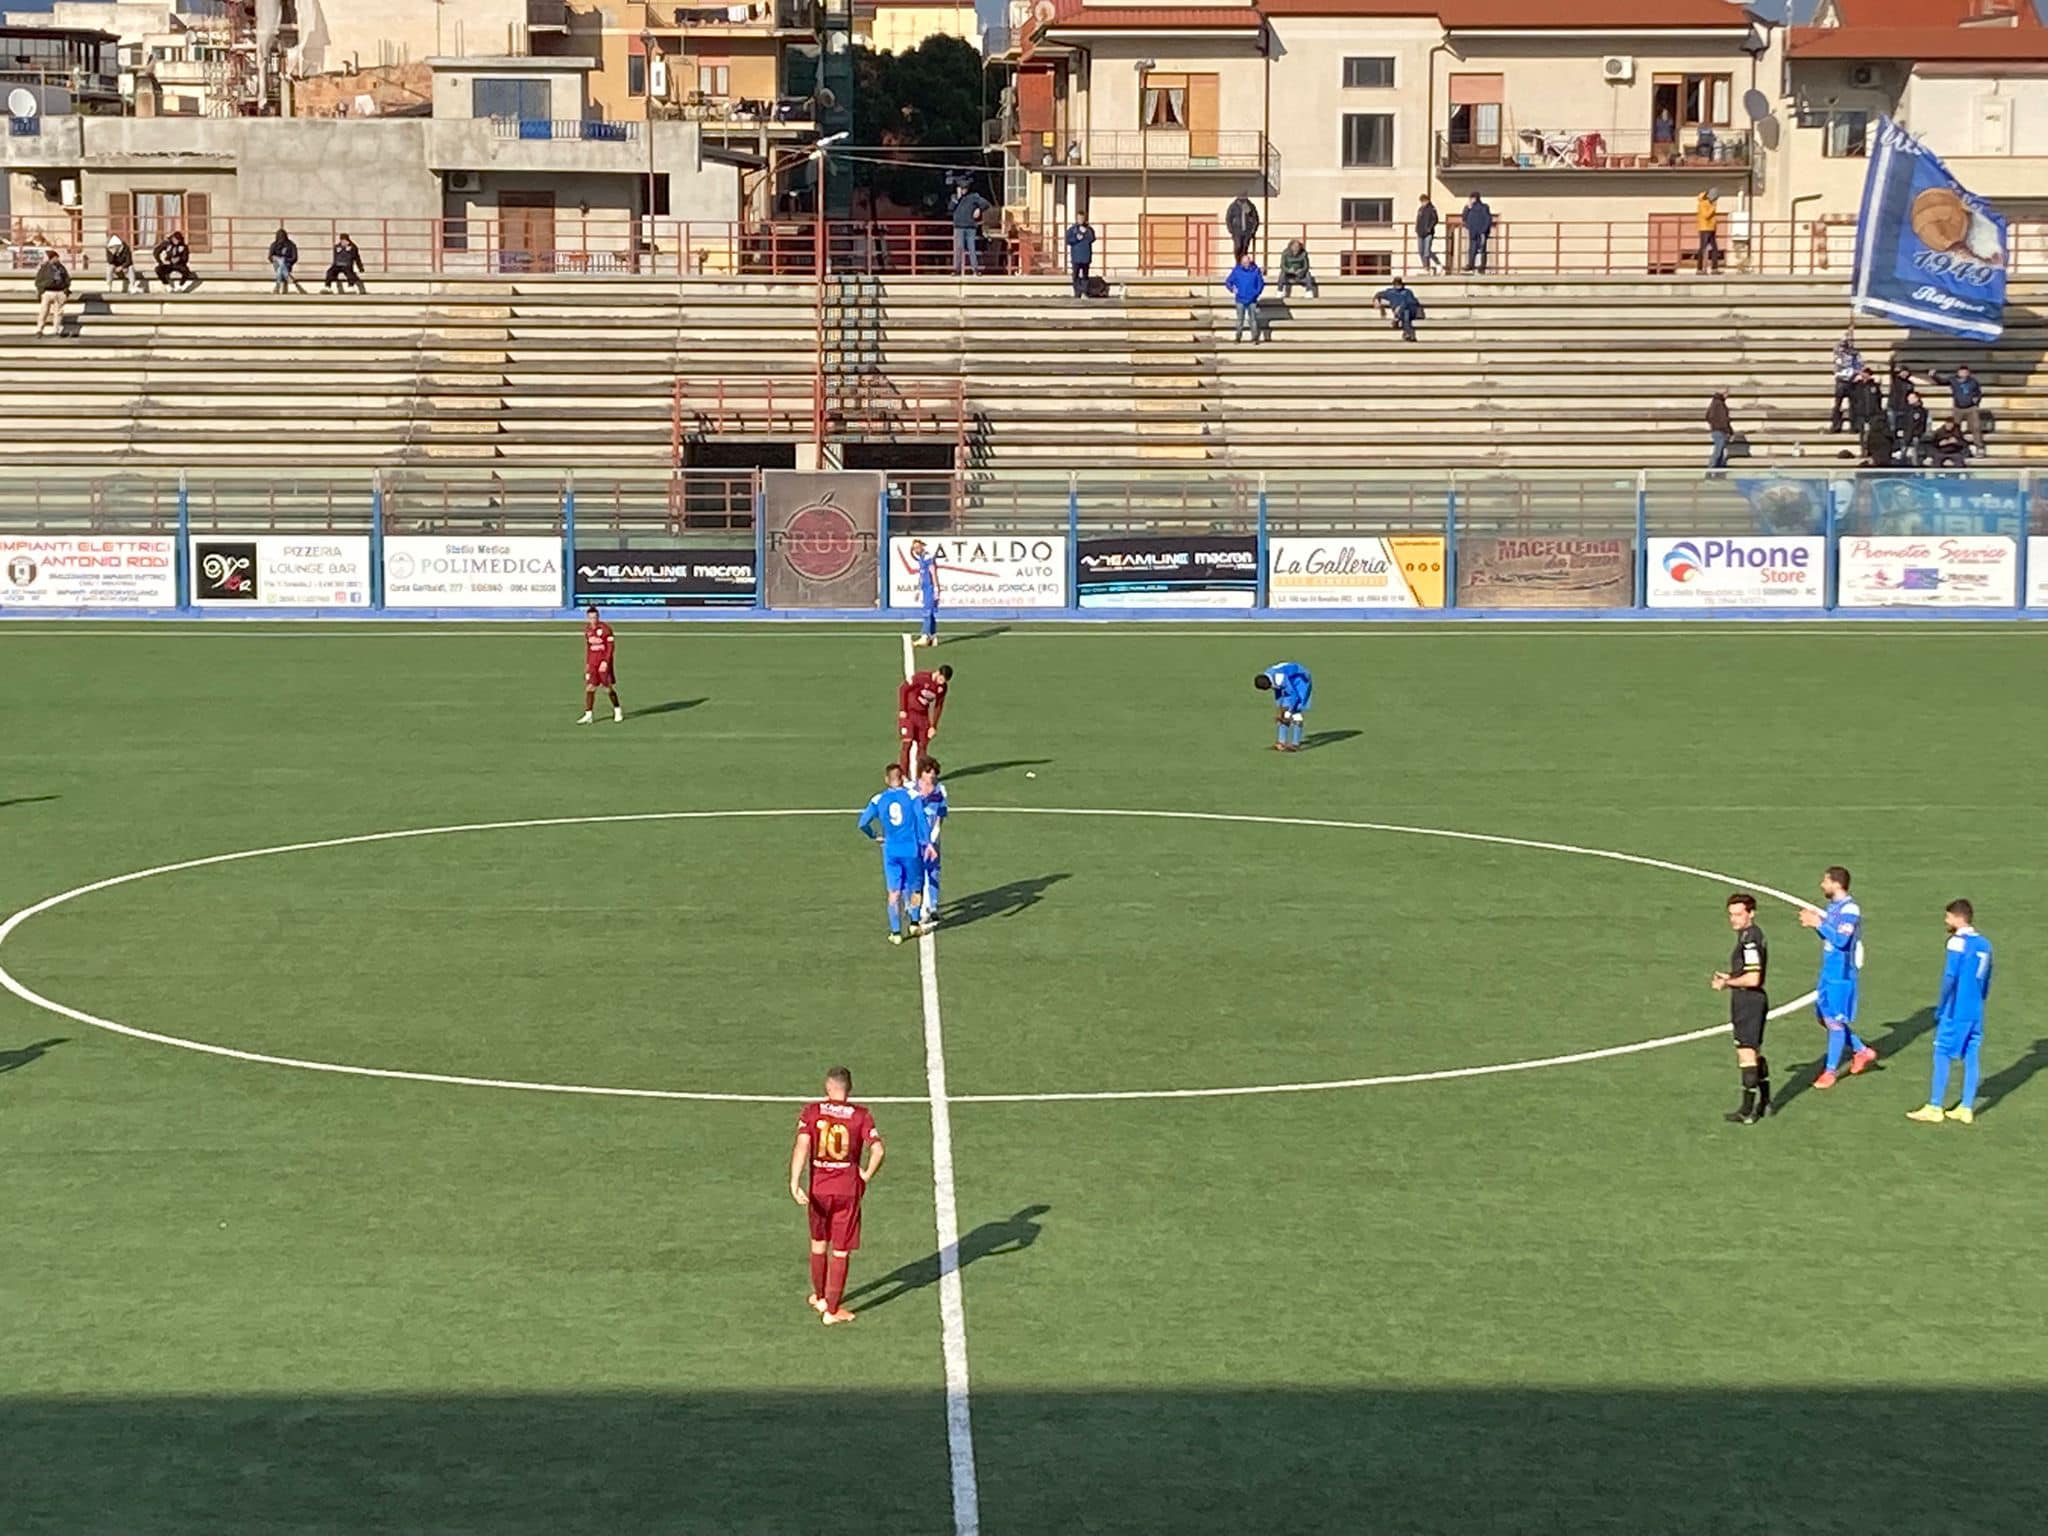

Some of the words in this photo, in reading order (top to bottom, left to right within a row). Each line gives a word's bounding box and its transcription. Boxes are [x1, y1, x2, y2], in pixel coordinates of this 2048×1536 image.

[77, 541, 171, 553] ELETTRICI
[283, 546, 342, 557] PIZZERIA
[1704, 539, 1810, 568] Phone
[40, 556, 122, 568] ANTONIO
[1194, 551, 1253, 565] macron
[1273, 546, 1303, 575] La
[1305, 546, 1389, 576] Galleria
[269, 562, 325, 574] LOUNGE
[328, 562, 357, 574] BAR
[421, 558, 556, 574] POLIMEDICA
[693, 564, 752, 578] macron
[1015, 567, 1053, 577] AUTO
[1760, 567, 1807, 584] Store
[889, 802, 904, 826] 9
[1976, 951, 1990, 979] 7
[817, 1120, 850, 1160] 10
